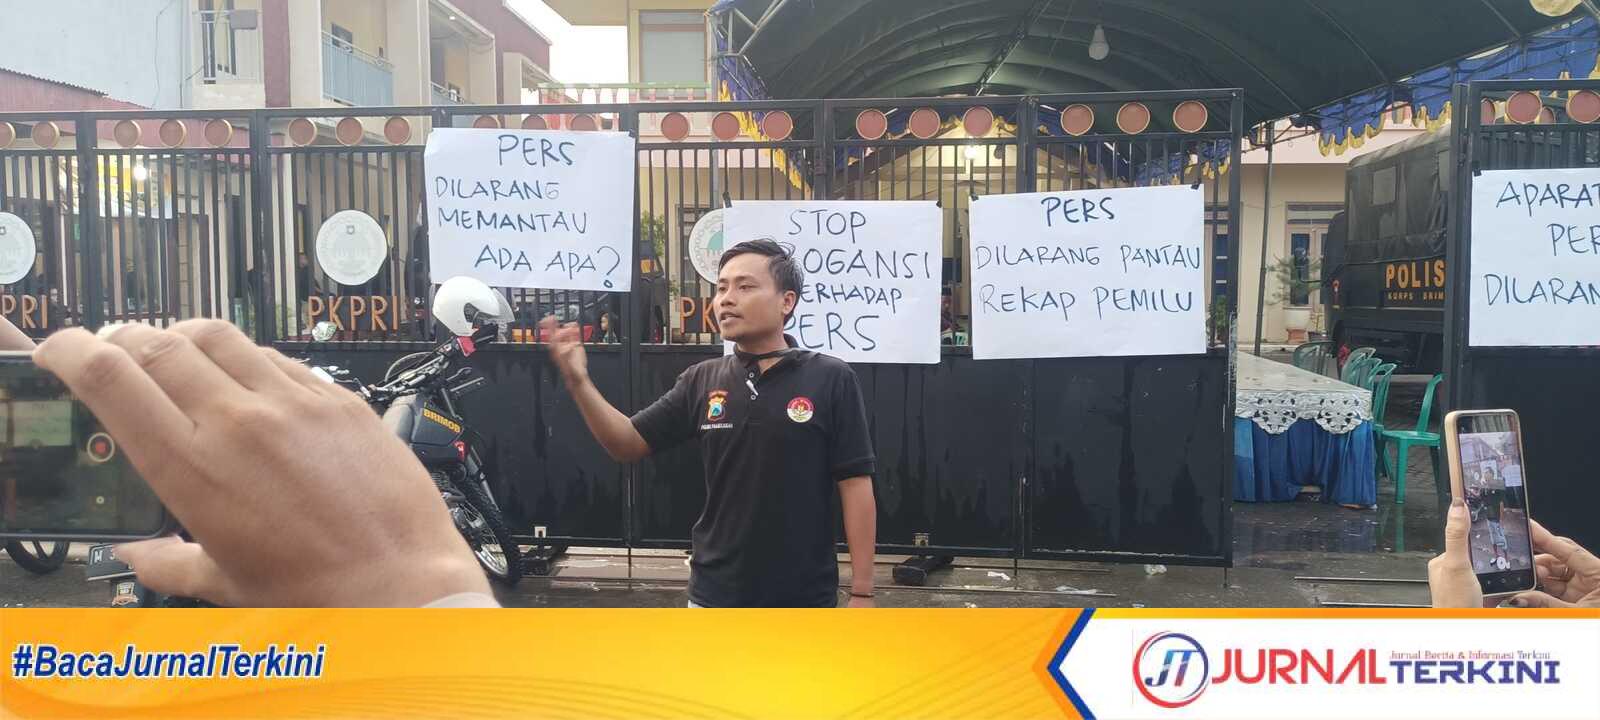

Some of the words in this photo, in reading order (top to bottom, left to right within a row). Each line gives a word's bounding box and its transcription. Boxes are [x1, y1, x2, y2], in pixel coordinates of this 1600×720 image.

[498, 134, 575, 167] PERS
[435, 176, 560, 201] DILARANG
[438, 207, 587, 234] MEMANTAU
[788, 209, 866, 243] STOP
[1041, 196, 1115, 228] PERS
[474, 244, 532, 271] ADA
[544, 246, 621, 289] APA?
[802, 248, 931, 279] OGANSI
[975, 245, 1100, 270] DILARANG
[1120, 244, 1201, 273] PANTAU
[1385, 260, 1445, 289] POLIS
[800, 282, 902, 313] ERHADAP
[979, 283, 1076, 321] REKAP
[1093, 286, 1193, 320] PEMILU
[308, 295, 398, 332] PKPRI
[423, 408, 461, 433] BRIMOB
